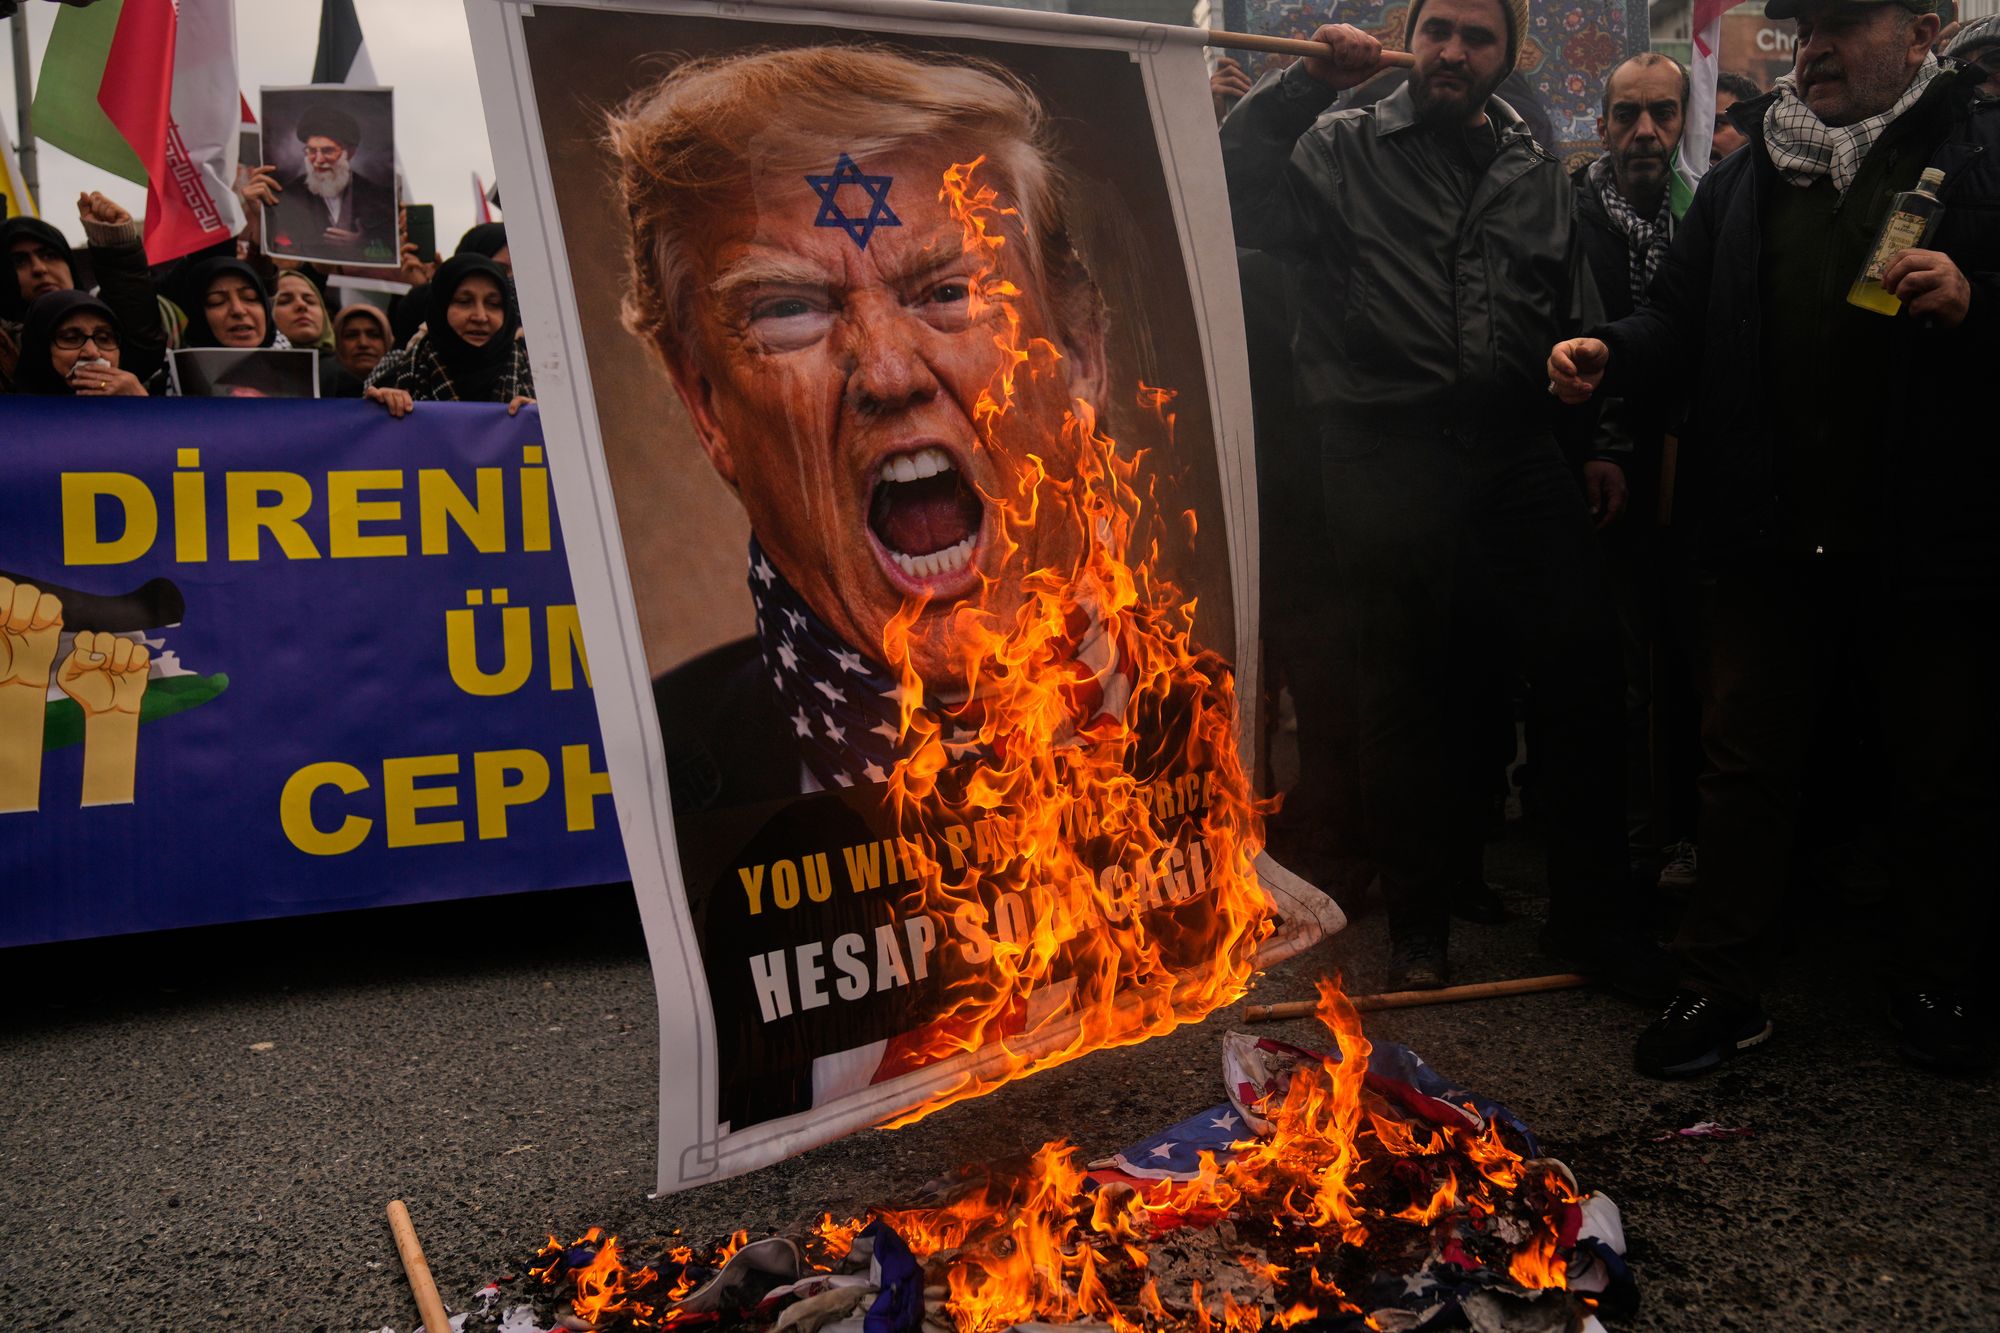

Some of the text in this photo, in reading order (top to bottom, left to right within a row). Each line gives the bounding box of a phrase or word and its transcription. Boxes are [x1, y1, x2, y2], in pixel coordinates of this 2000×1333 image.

[61, 446, 551, 565] DİRENİ
[738, 852, 832, 915] YOU
[843, 833, 934, 893] WILL
[749, 915, 936, 1024] HESAP
